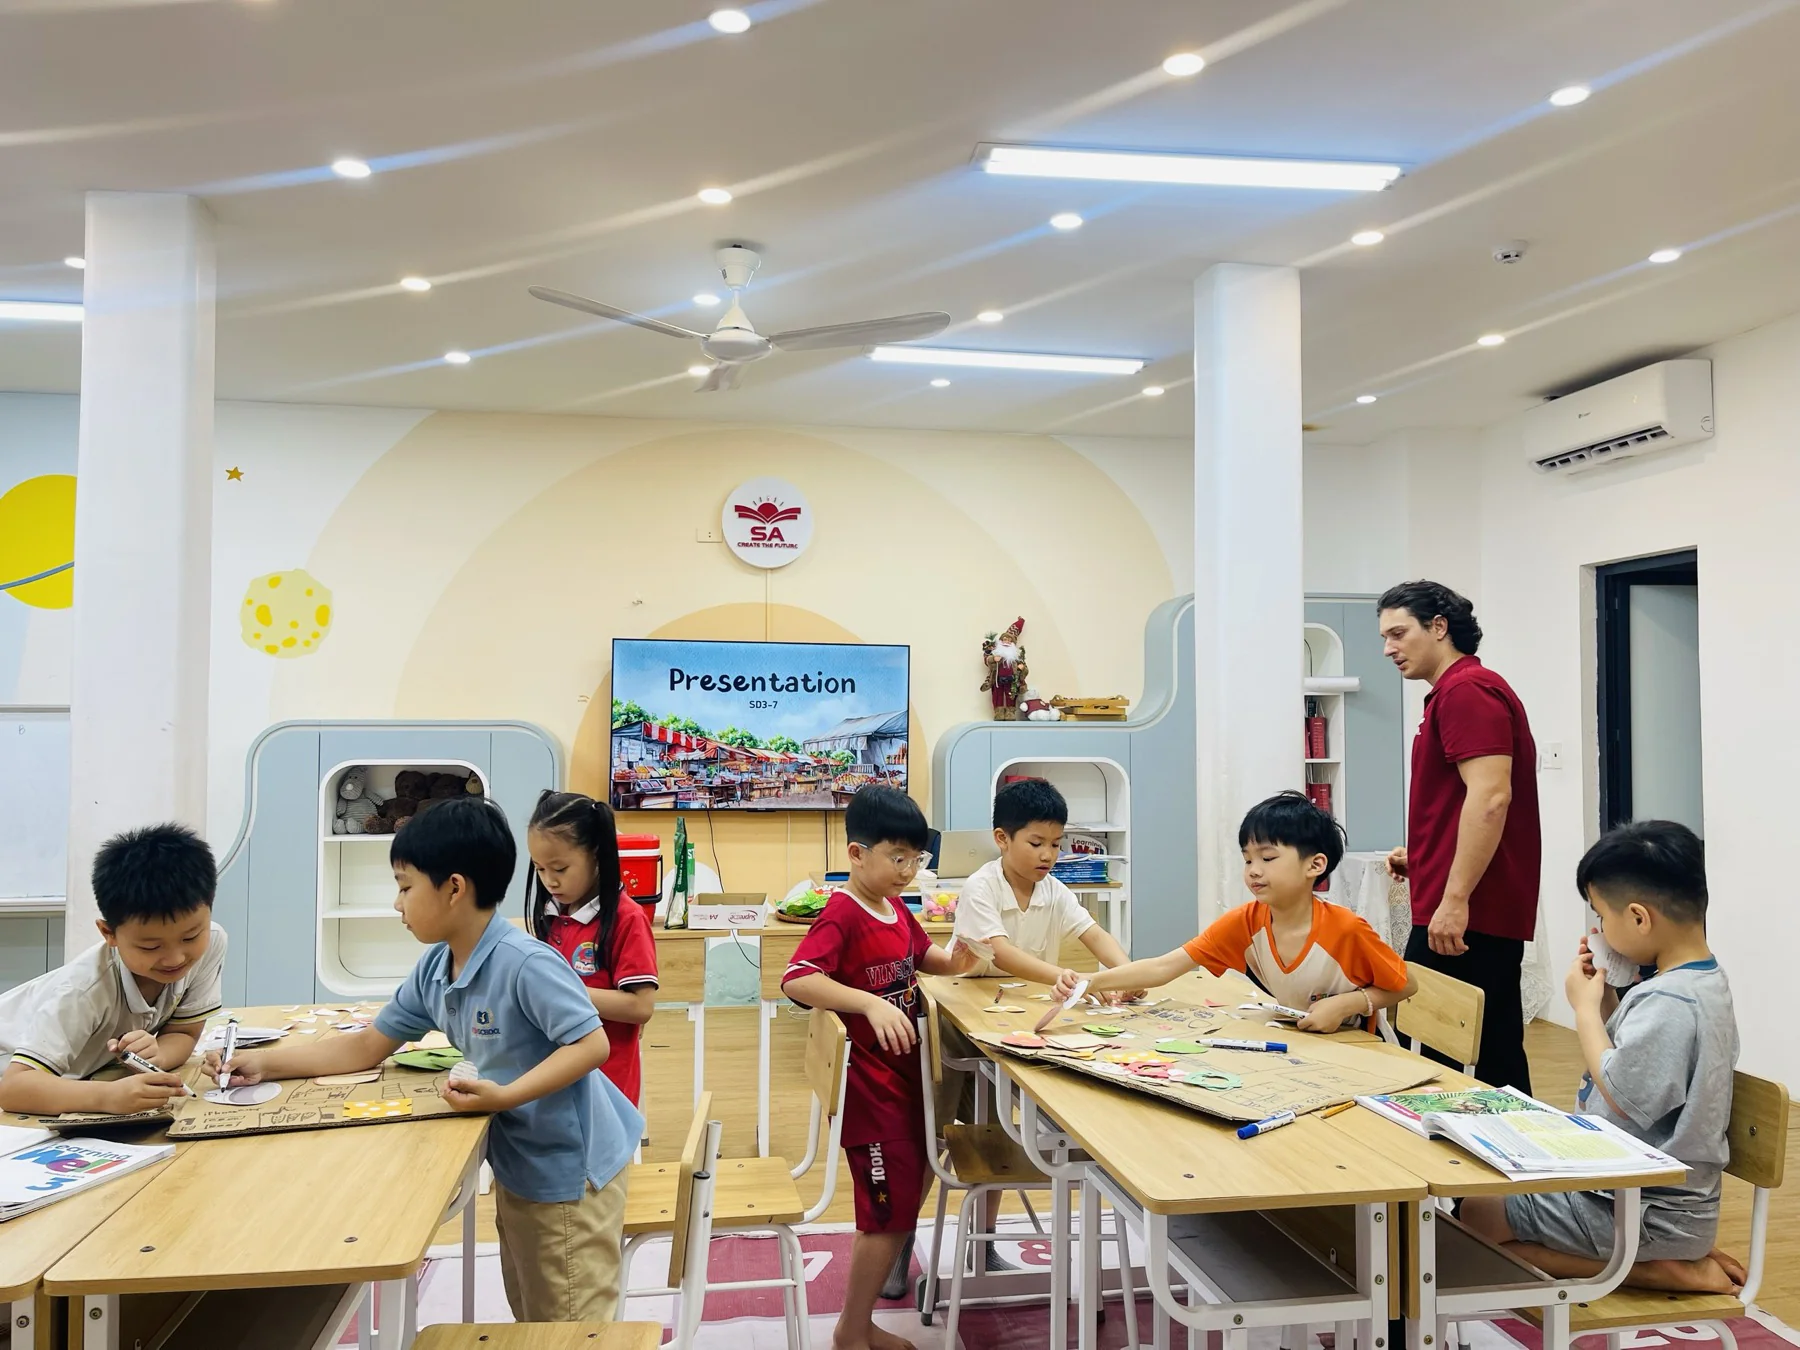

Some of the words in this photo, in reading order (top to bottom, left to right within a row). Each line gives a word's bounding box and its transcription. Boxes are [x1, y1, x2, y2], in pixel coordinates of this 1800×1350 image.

[750, 526, 784, 541] SA
[669, 668, 856, 694] Presentation
[749, 700, 778, 709] SD3-7
[11, 1147, 128, 1174] Well
[25, 1177, 77, 1191] 3
